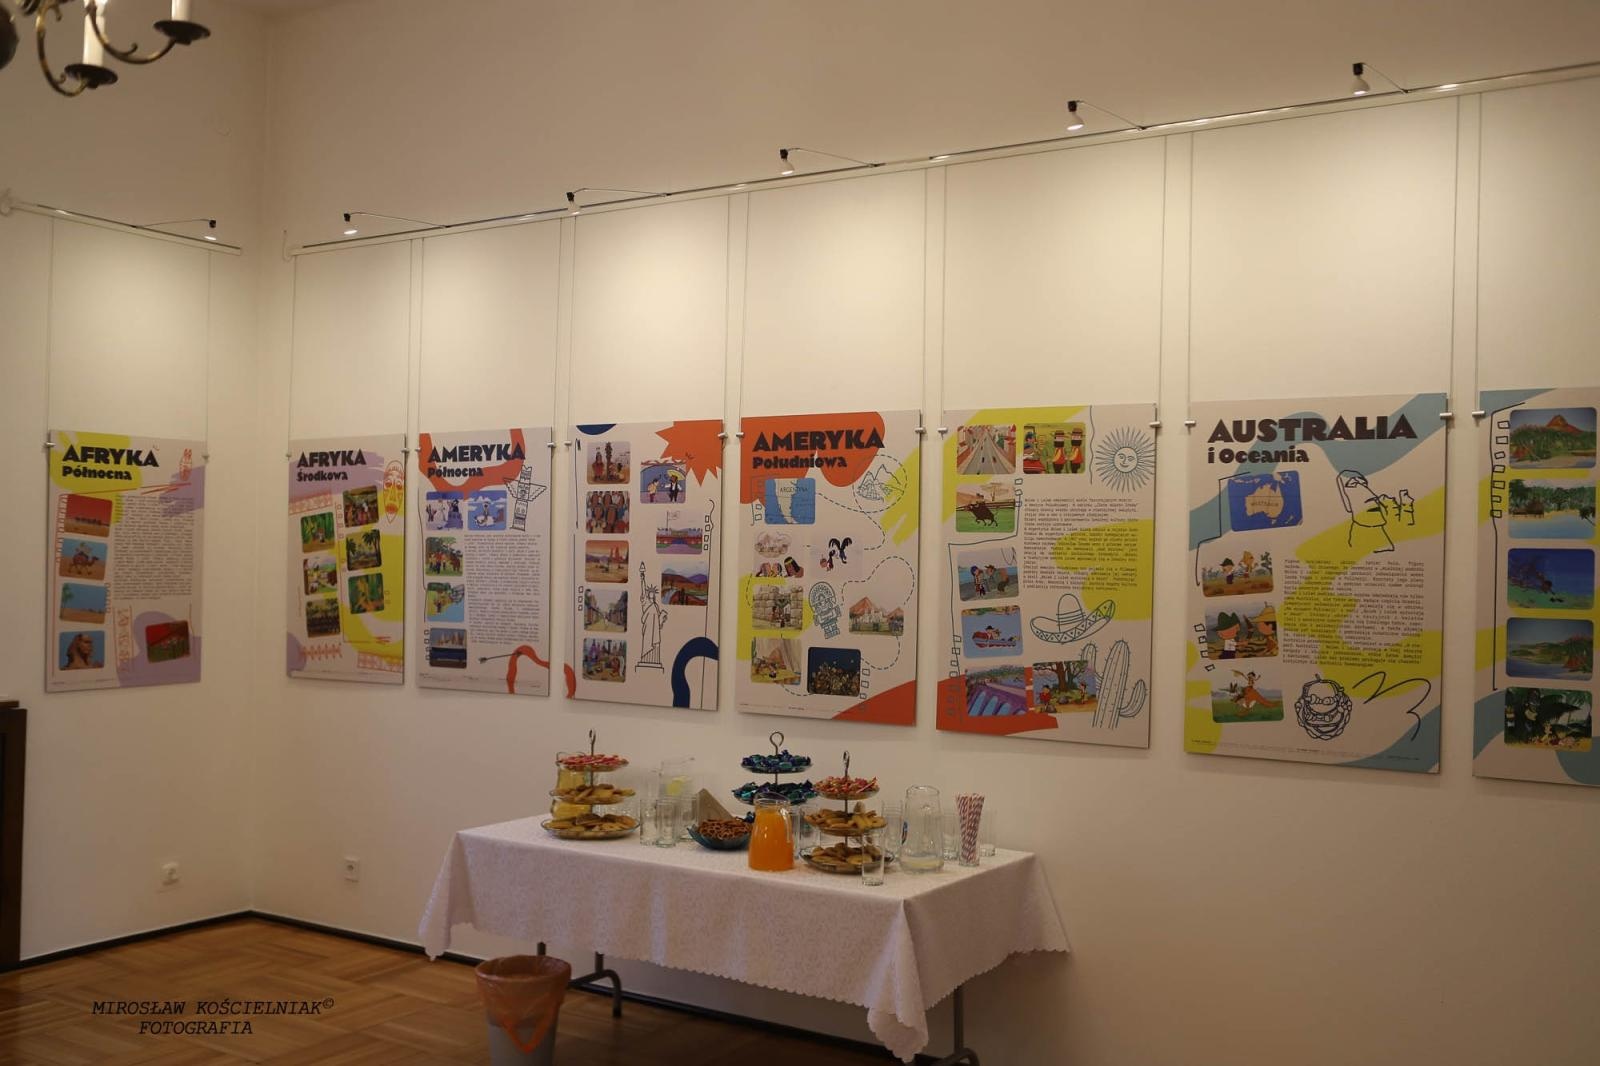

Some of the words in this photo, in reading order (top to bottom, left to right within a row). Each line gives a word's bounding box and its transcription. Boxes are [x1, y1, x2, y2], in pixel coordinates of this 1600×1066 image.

[1208, 414, 1417, 443] AUSTRALIA
[753, 427, 885, 452] AMERYKA
[62, 444, 159, 468] AFRYKA
[297, 449, 367, 468] AFRYKA
[428, 443, 526, 464] AMERYKA
[752, 454, 848, 469] Południowa
[1207, 447, 1214, 463] i
[1218, 445, 1309, 463] Oceania
[62, 465, 132, 480] Północna
[297, 468, 348, 482] Środkowa
[428, 465, 484, 478] Północna
